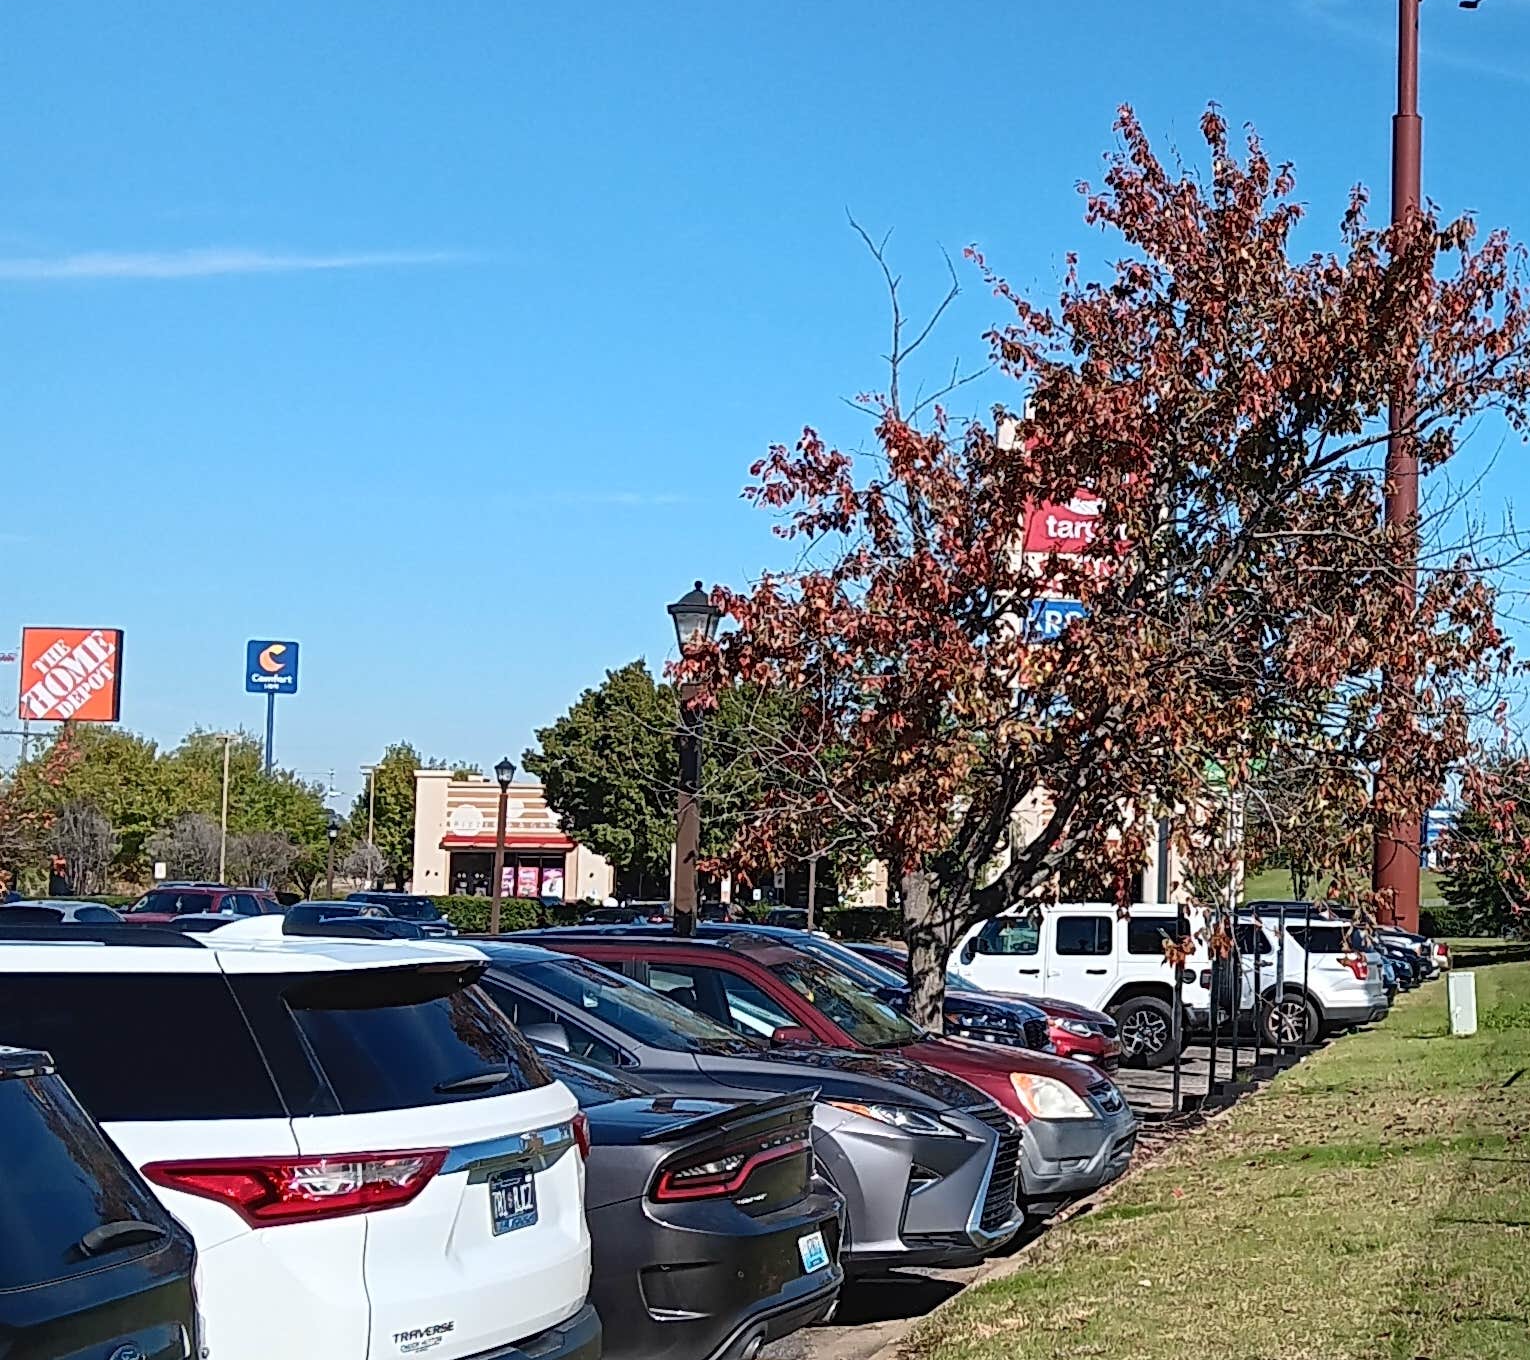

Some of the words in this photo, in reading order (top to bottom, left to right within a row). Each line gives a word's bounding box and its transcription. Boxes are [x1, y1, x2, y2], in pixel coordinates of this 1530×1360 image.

[20, 630, 116, 718] HOME
[31, 638, 72, 675] THE
[55, 661, 114, 718] DEPOT
[392, 1320, 455, 1345] TRAVERSE
